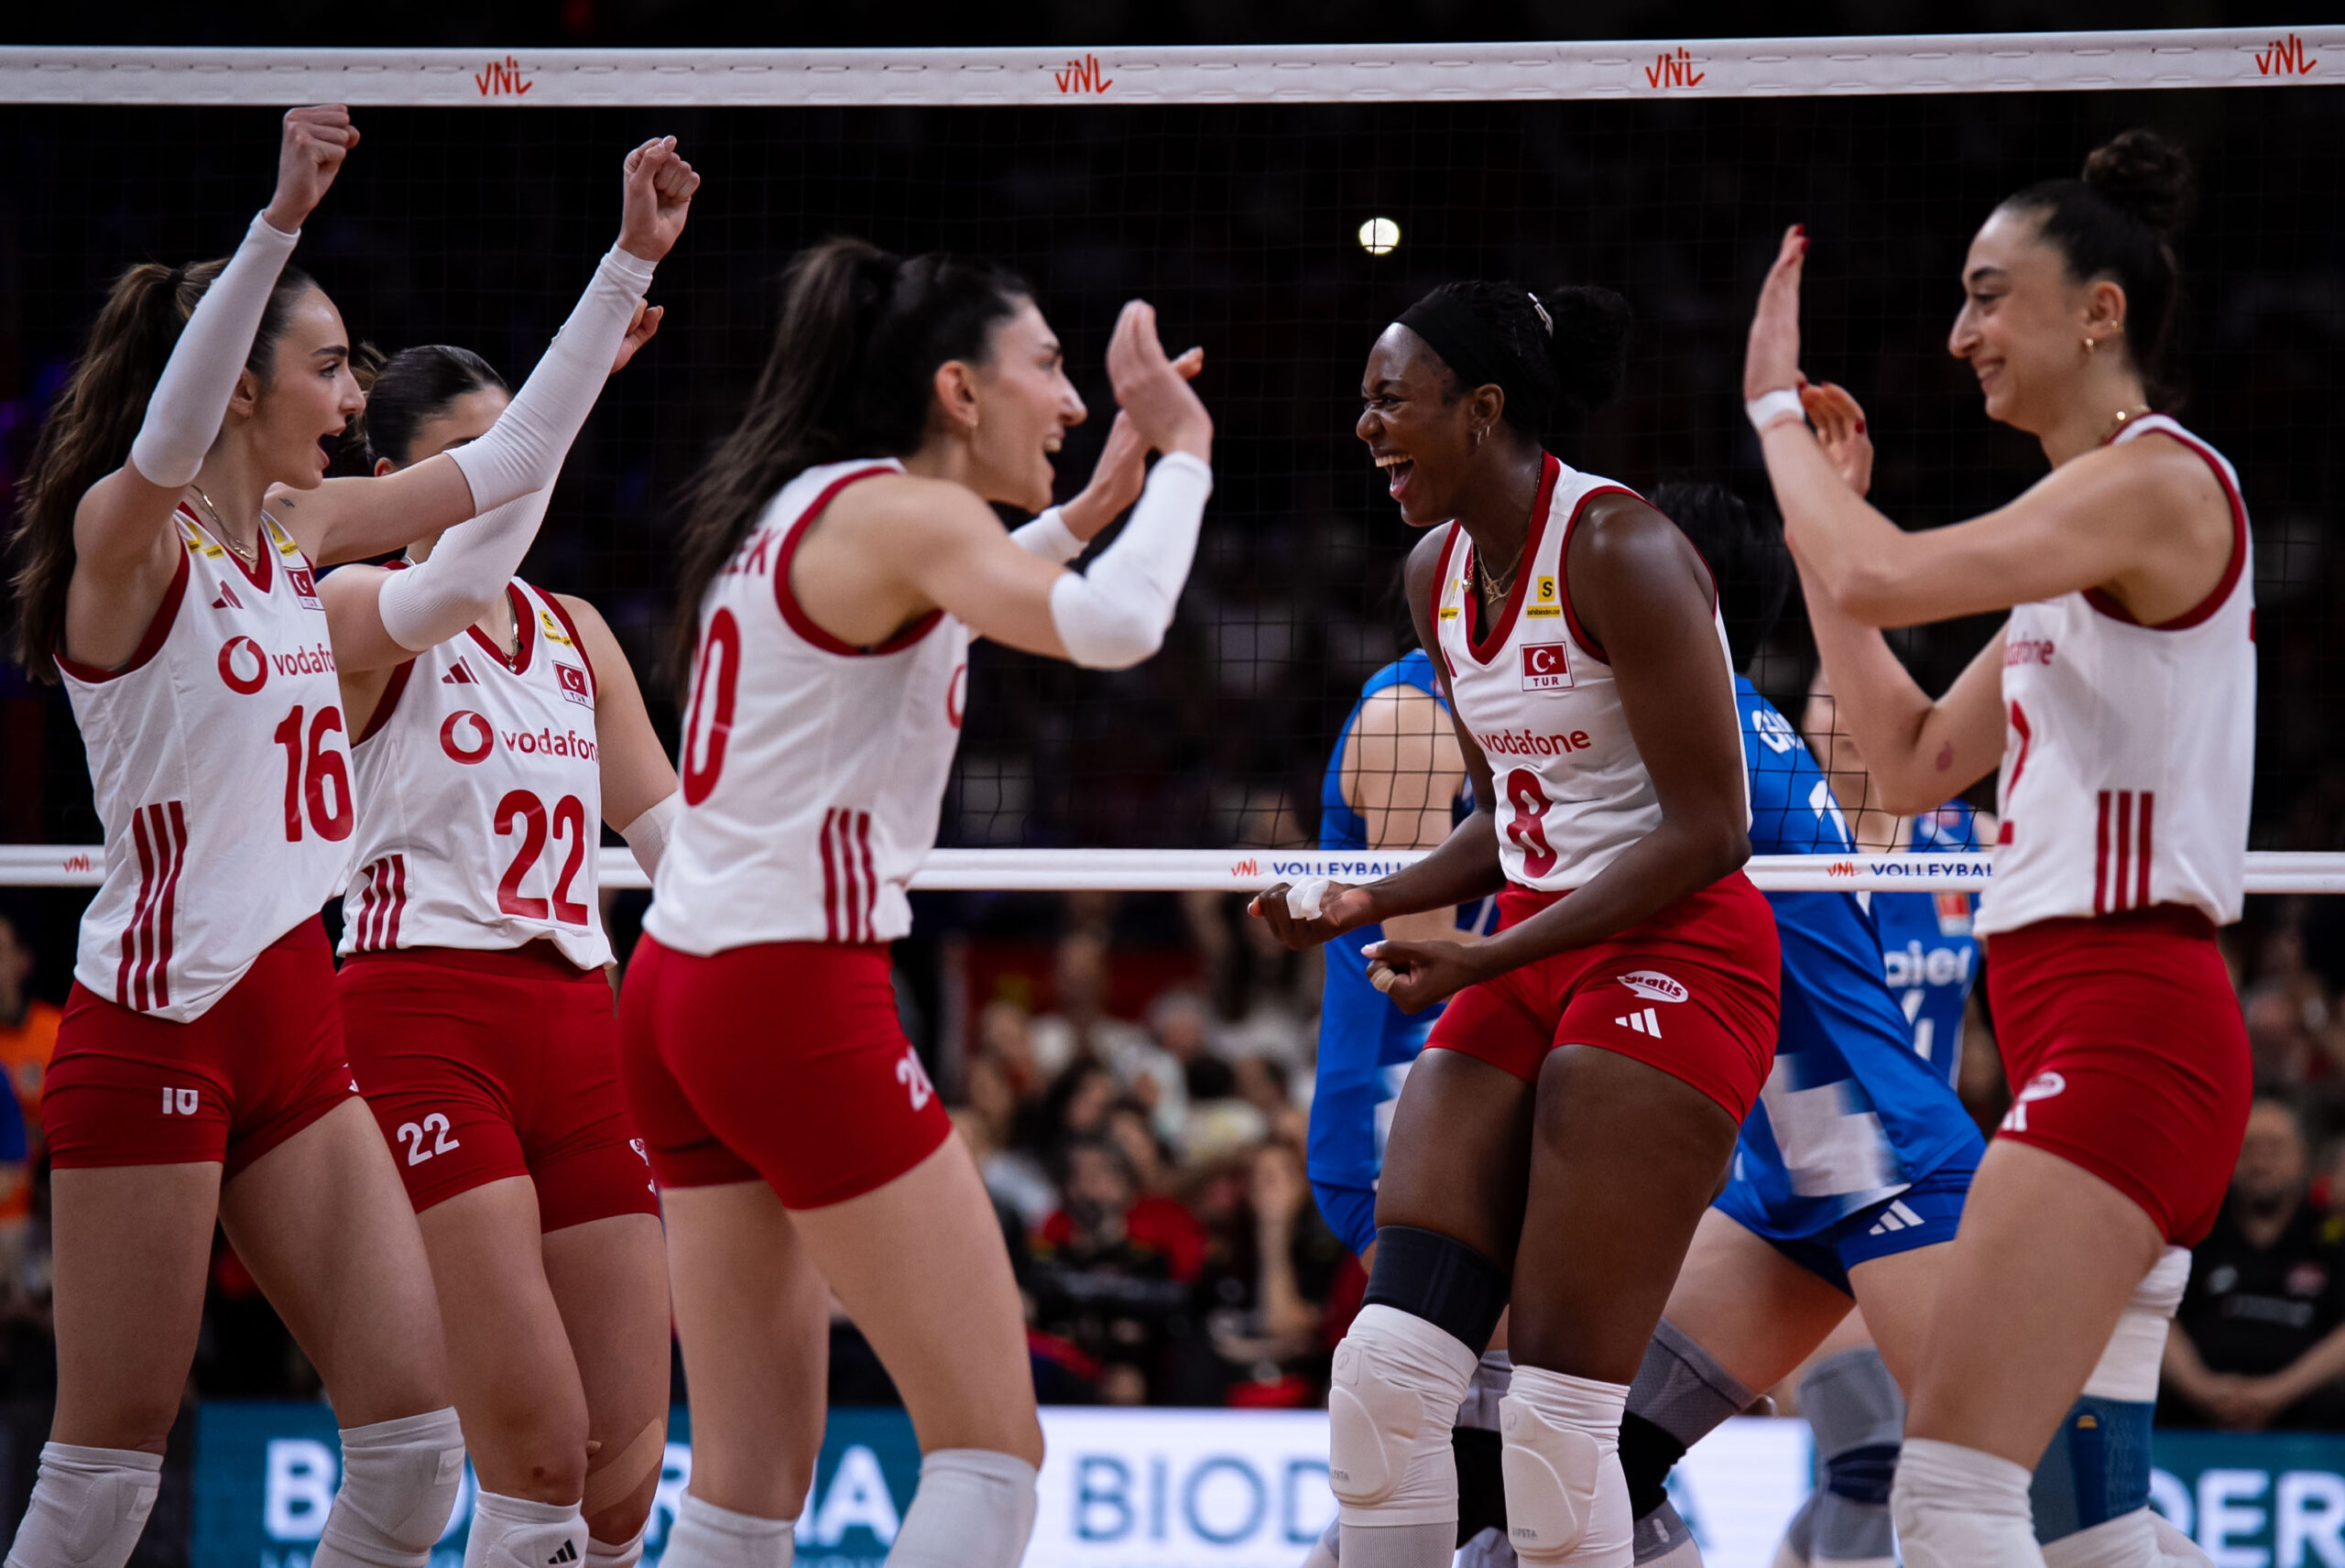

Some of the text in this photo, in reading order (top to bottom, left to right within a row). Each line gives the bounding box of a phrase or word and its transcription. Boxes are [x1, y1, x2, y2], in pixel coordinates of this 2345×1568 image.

[1055, 53, 1113, 93] VNL
[1645, 47, 1705, 88] VNL
[2255, 33, 2318, 75] VNL
[475, 55, 532, 95] VNL
[1542, 581, 1553, 597] S
[1532, 676, 1559, 687] TUR
[501, 727, 600, 765] vodafon
[1478, 729, 1591, 756] vodafone
[274, 704, 354, 842] 16
[1507, 768, 1557, 878] 8
[62, 854, 95, 873] VNL
[494, 789, 588, 926] 22
[1231, 858, 1264, 877] VNL
[1827, 861, 1993, 877] VNL VOLLEYBAL
[397, 1113, 460, 1166] 22
